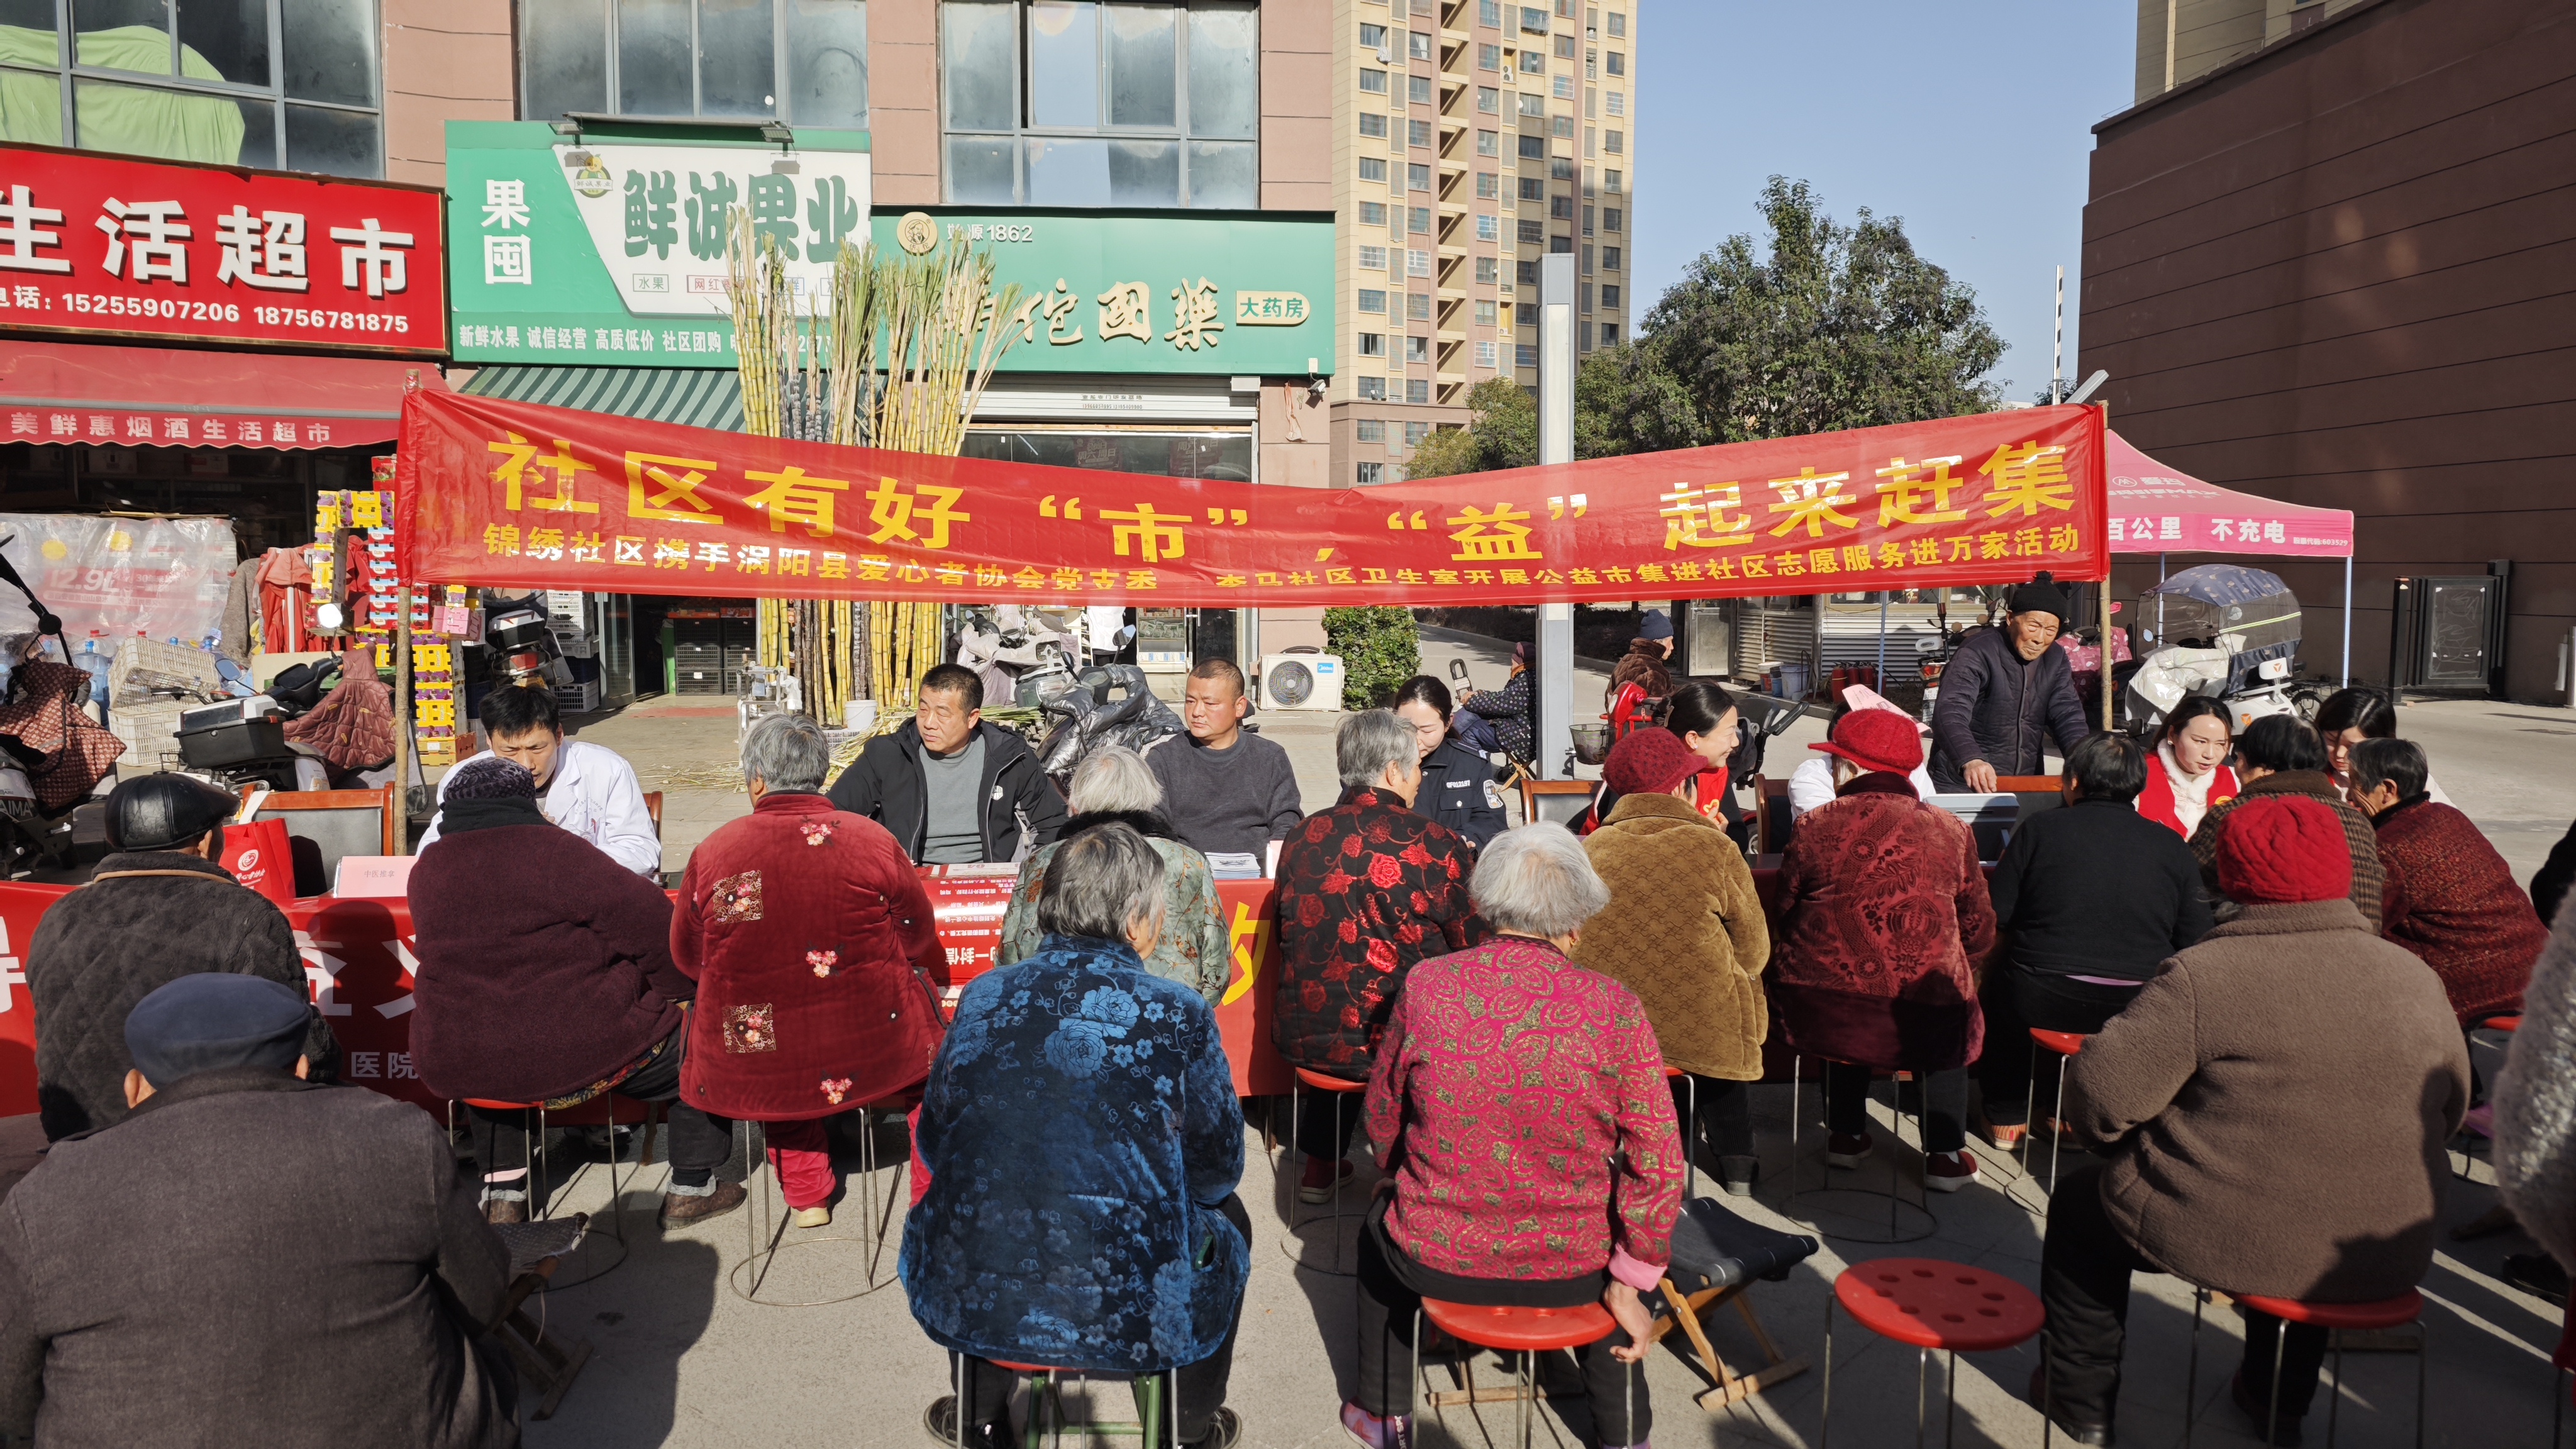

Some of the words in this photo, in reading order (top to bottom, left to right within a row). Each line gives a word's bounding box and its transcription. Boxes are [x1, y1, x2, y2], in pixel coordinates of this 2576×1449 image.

[624, 170, 859, 263] 鲜诚果业
[0, 184, 414, 297] 生活超市
[481, 179, 532, 285] 果囤
[638, 277, 664, 289] 水果
[62, 294, 240, 321] 15255907206
[253, 306, 409, 333] 18756781875
[1240, 296, 1304, 319] 大药房
[459, 325, 520, 348] 新鲜水果
[527, 327, 587, 350] 诚信经营
[595, 328, 654, 352] 高质低价
[662, 331, 721, 352] 社区团购
[11, 412, 330, 443] 美鲜惠烟酒生活超市
[2108, 517, 2182, 540] 百公里
[2211, 519, 2285, 543] 不充电
[50, 569, 119, 593] 12.9L
